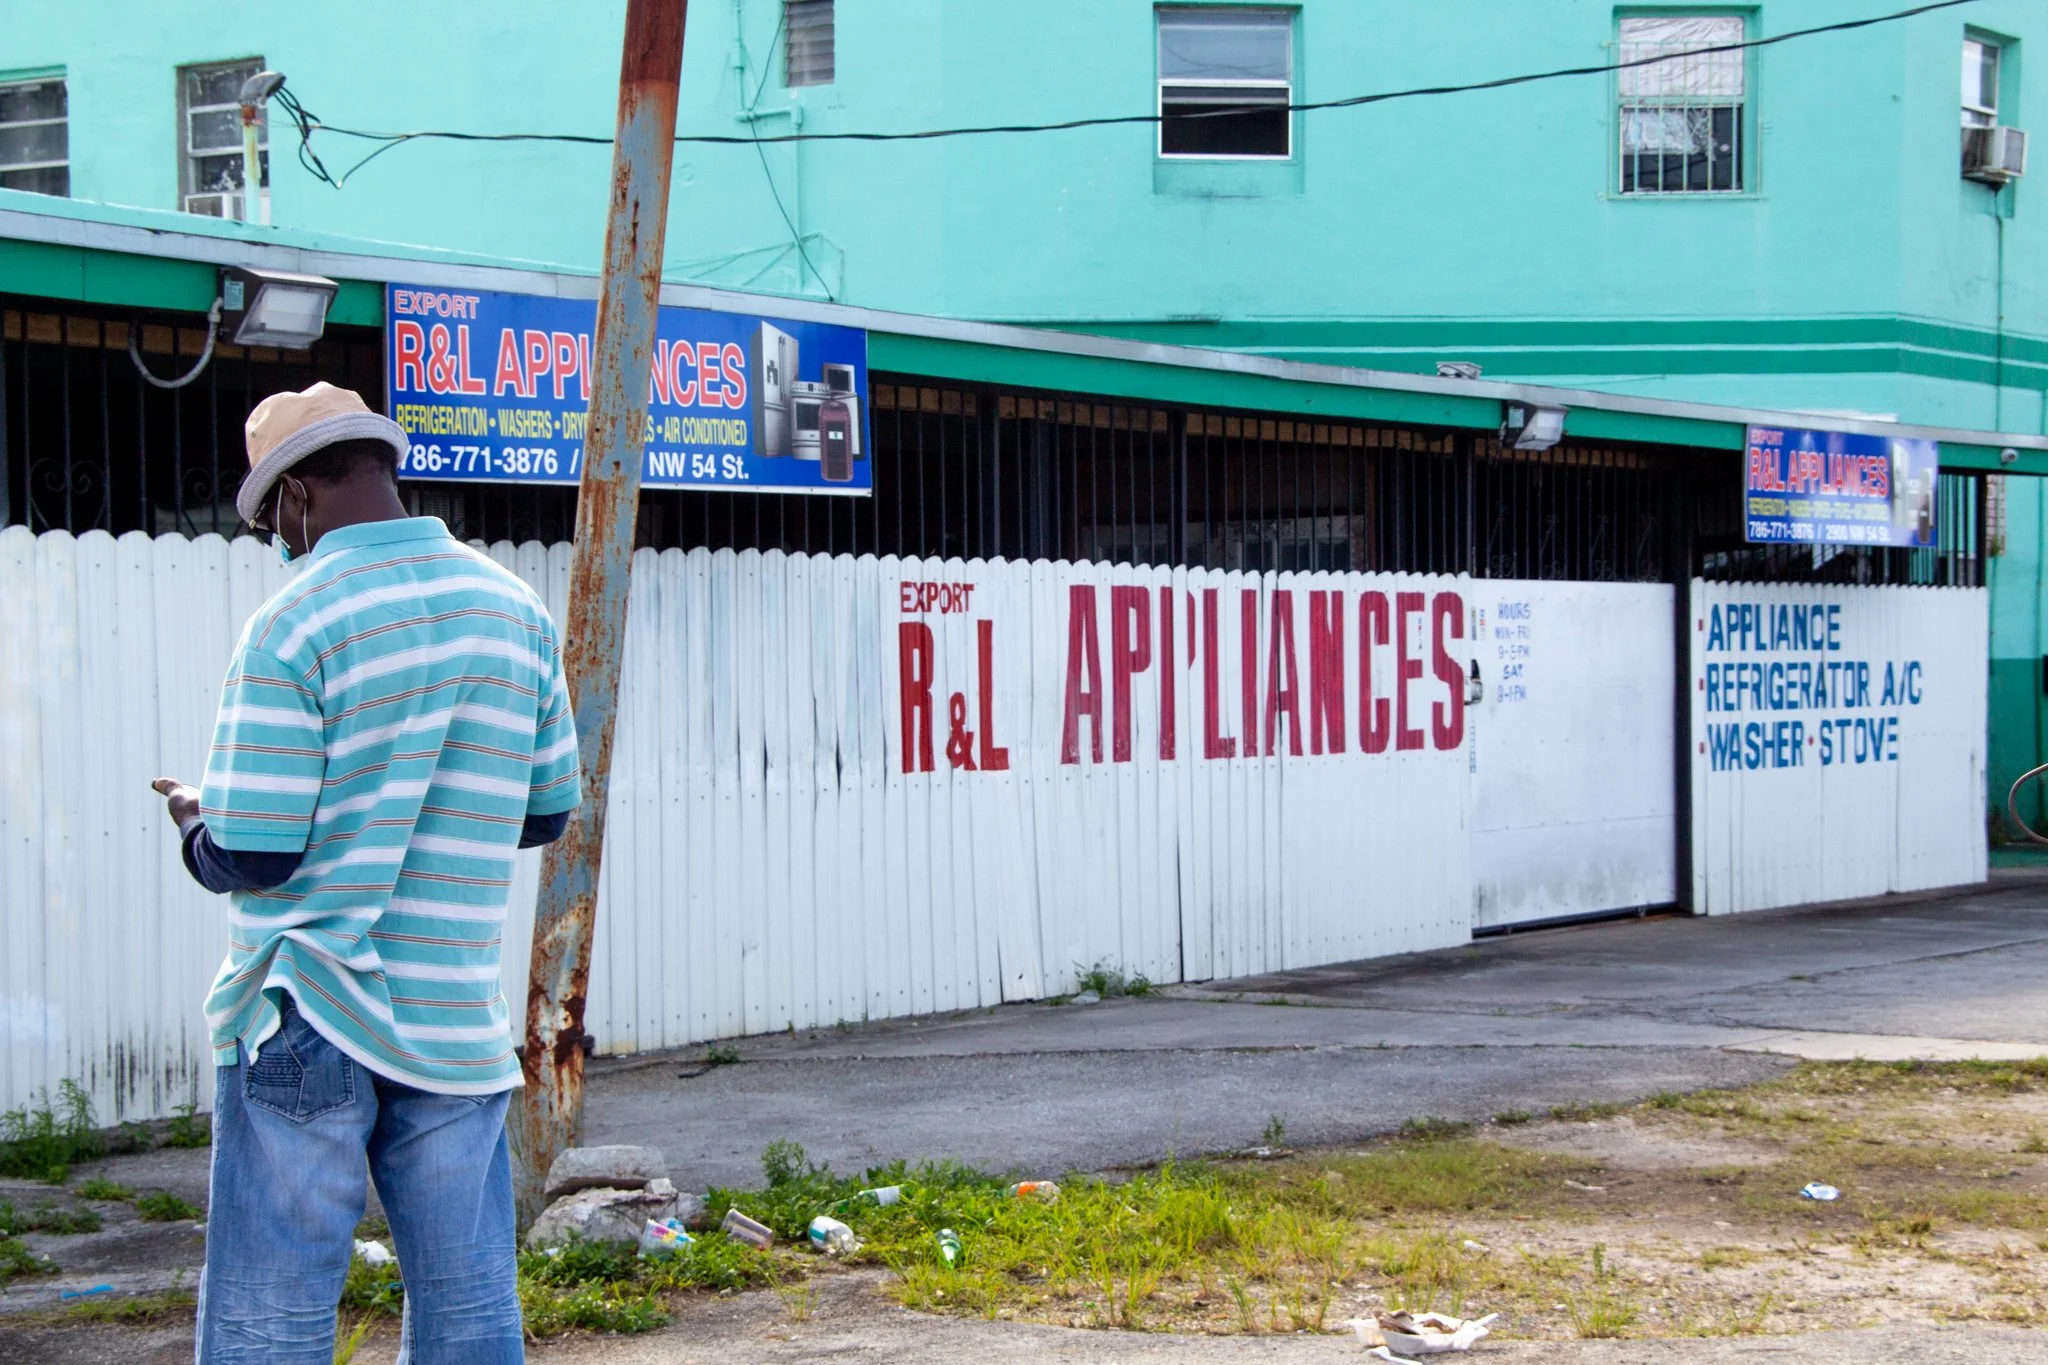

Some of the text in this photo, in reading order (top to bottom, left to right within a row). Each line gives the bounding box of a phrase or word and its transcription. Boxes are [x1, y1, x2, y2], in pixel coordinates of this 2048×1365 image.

[395, 289, 480, 319] EXPORT
[395, 319, 747, 410] R&L APPLNCES
[396, 404, 488, 437] REFRIGERATION
[497, 408, 553, 440] WASHERS
[664, 416, 681, 443] AIR
[682, 416, 748, 446] CONDITIONED
[1750, 428, 1784, 446] EXPORT
[399, 444, 558, 475] 786-771-3876
[648, 451, 686, 477] NW
[691, 453, 716, 479] 54
[722, 453, 750, 480] St.
[1749, 447, 1888, 498] R&L APPLIANCES
[900, 581, 975, 614] EXPORT
[1498, 602, 1531, 620] HOURS
[1706, 603, 1841, 652] APPLIANCE
[1060, 585, 1465, 765] APPLIANCES
[1503, 663, 1523, 680] SAT
[1706, 660, 1922, 712] REFRIGERATOR A/C
[1706, 716, 1900, 771] WASHER STOVE
